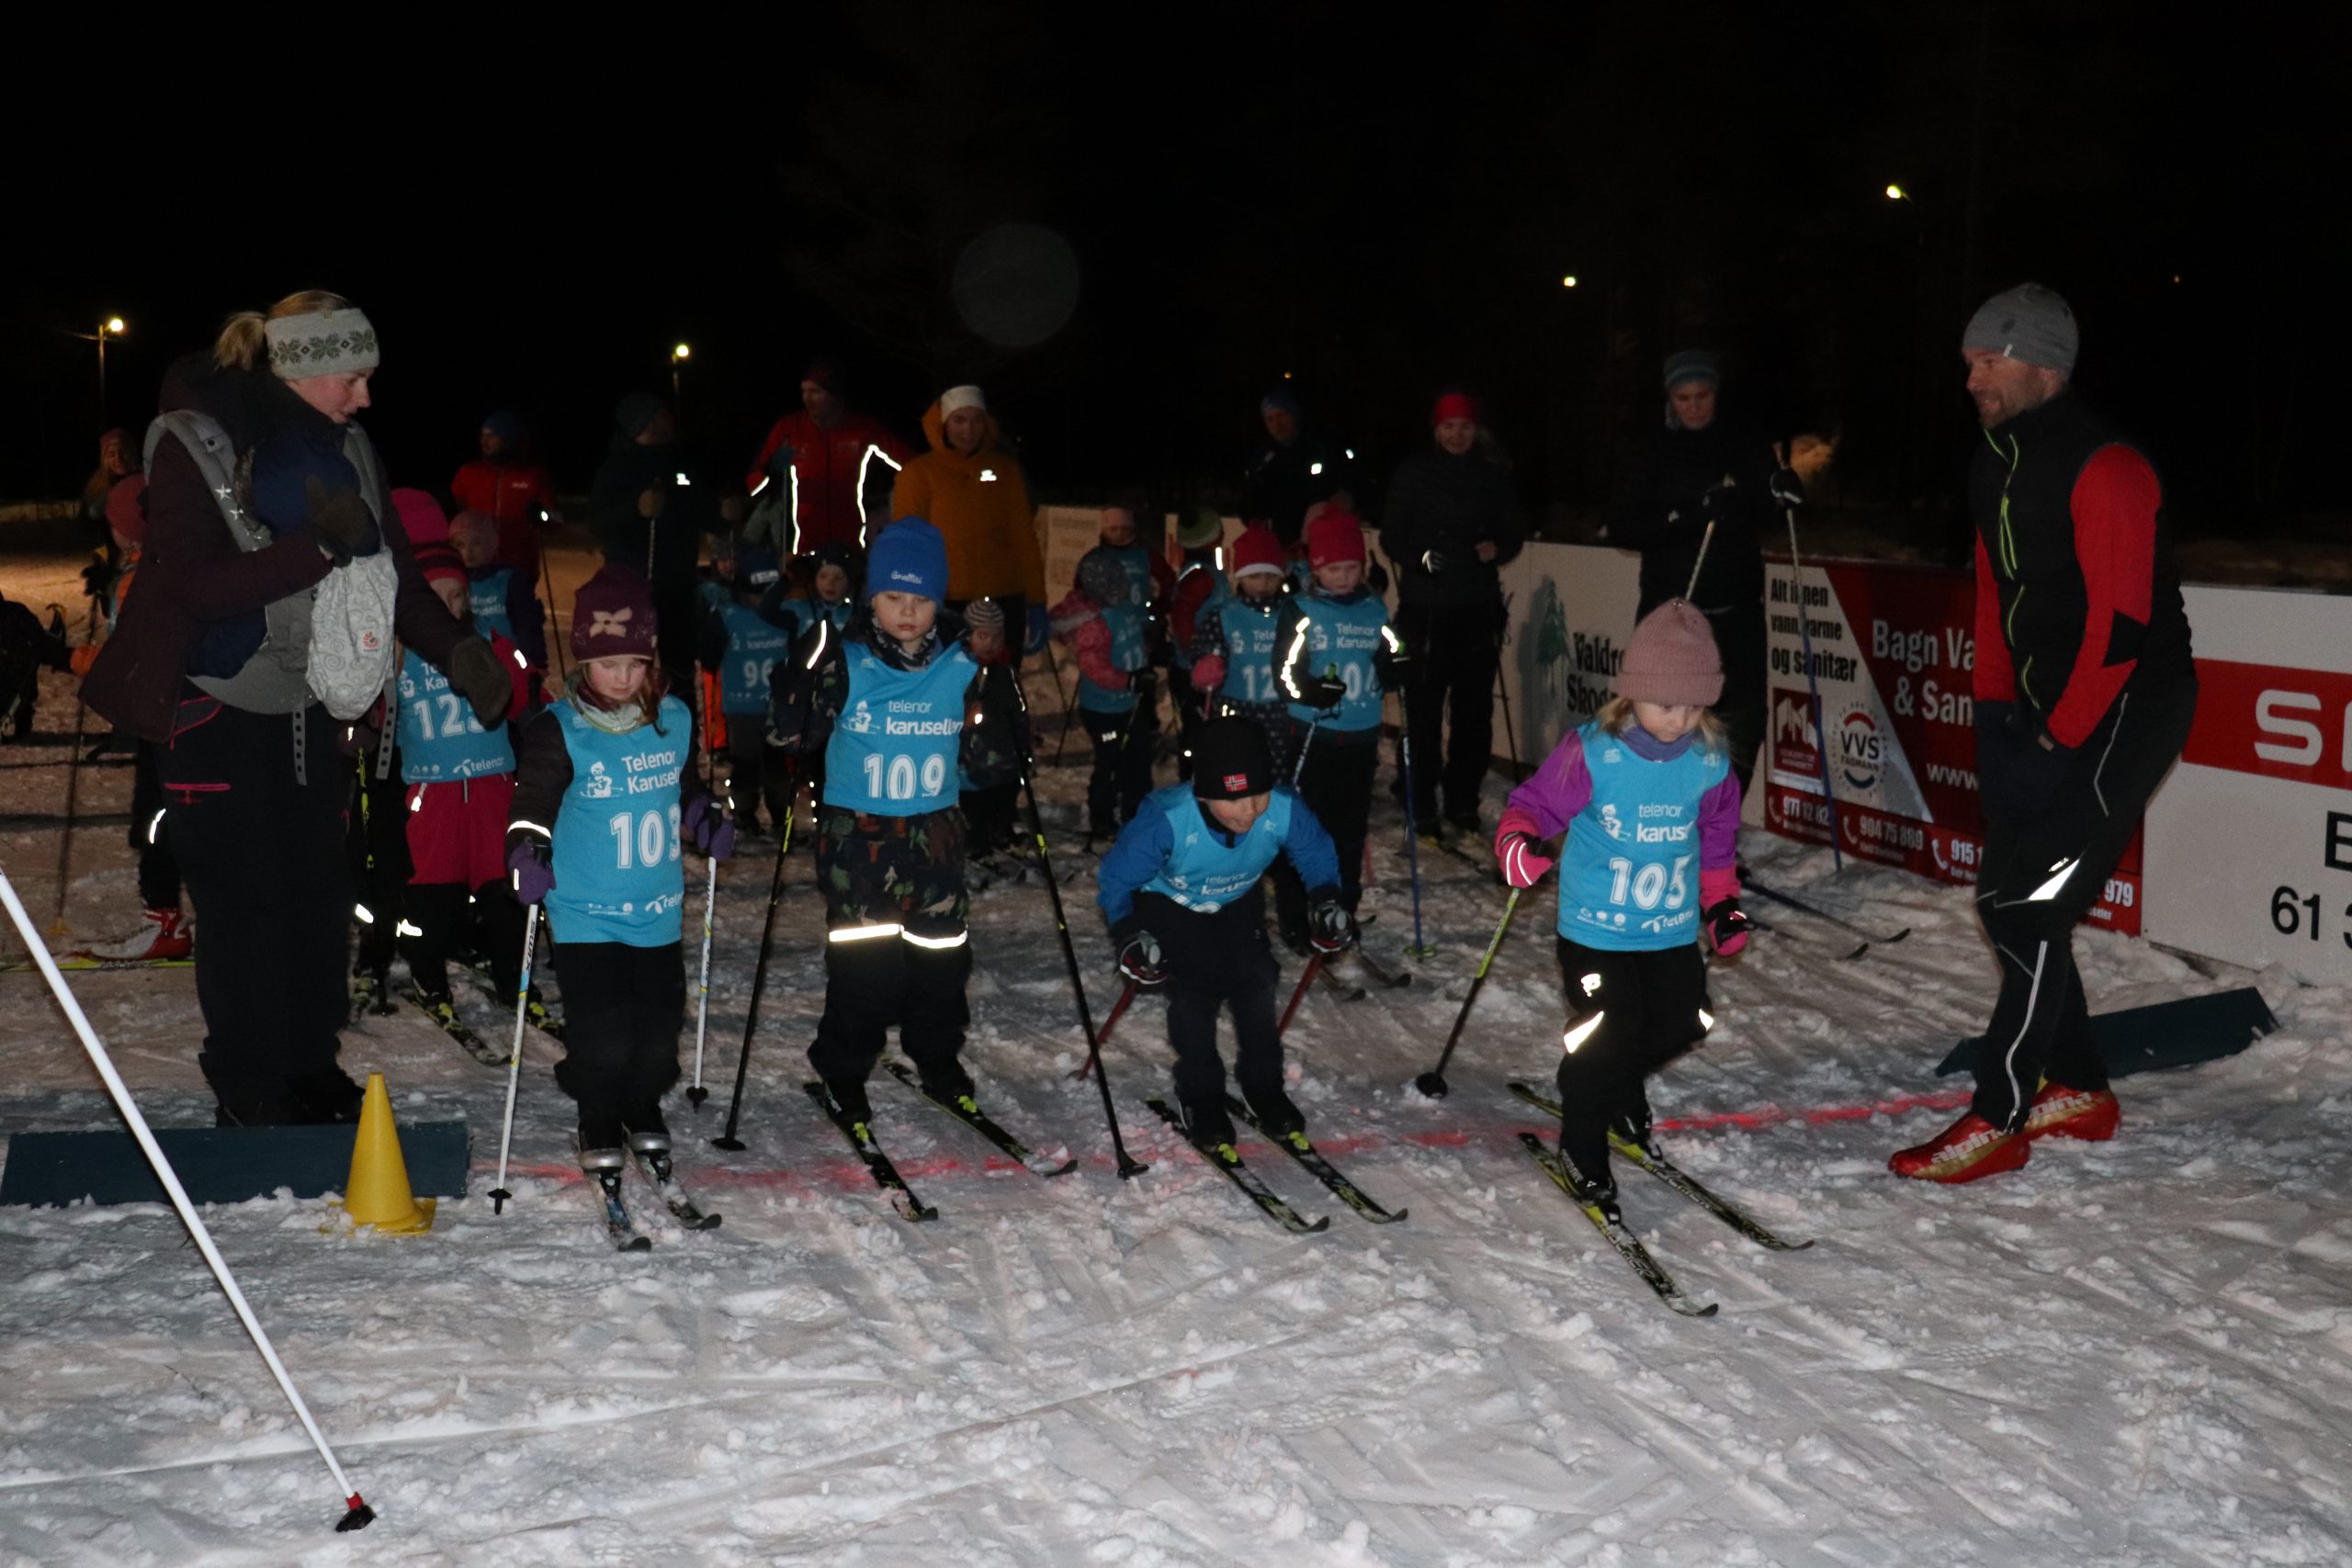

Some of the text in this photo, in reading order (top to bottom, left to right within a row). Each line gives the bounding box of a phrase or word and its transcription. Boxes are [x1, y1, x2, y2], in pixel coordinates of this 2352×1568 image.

[1770, 578, 1788, 604] Alt
[1871, 617, 1939, 674] Bagn
[1771, 647, 1790, 676] og
[888, 699, 933, 715] telenor
[1894, 675, 1916, 717] &
[1840, 730, 1880, 761] VVS
[620, 750, 676, 773] Telenor
[864, 752, 946, 800] 109
[1637, 803, 1683, 818] telenor
[1950, 838, 1975, 865] 915
[1609, 853, 1693, 910] 105
[2270, 885, 2321, 942] 61
